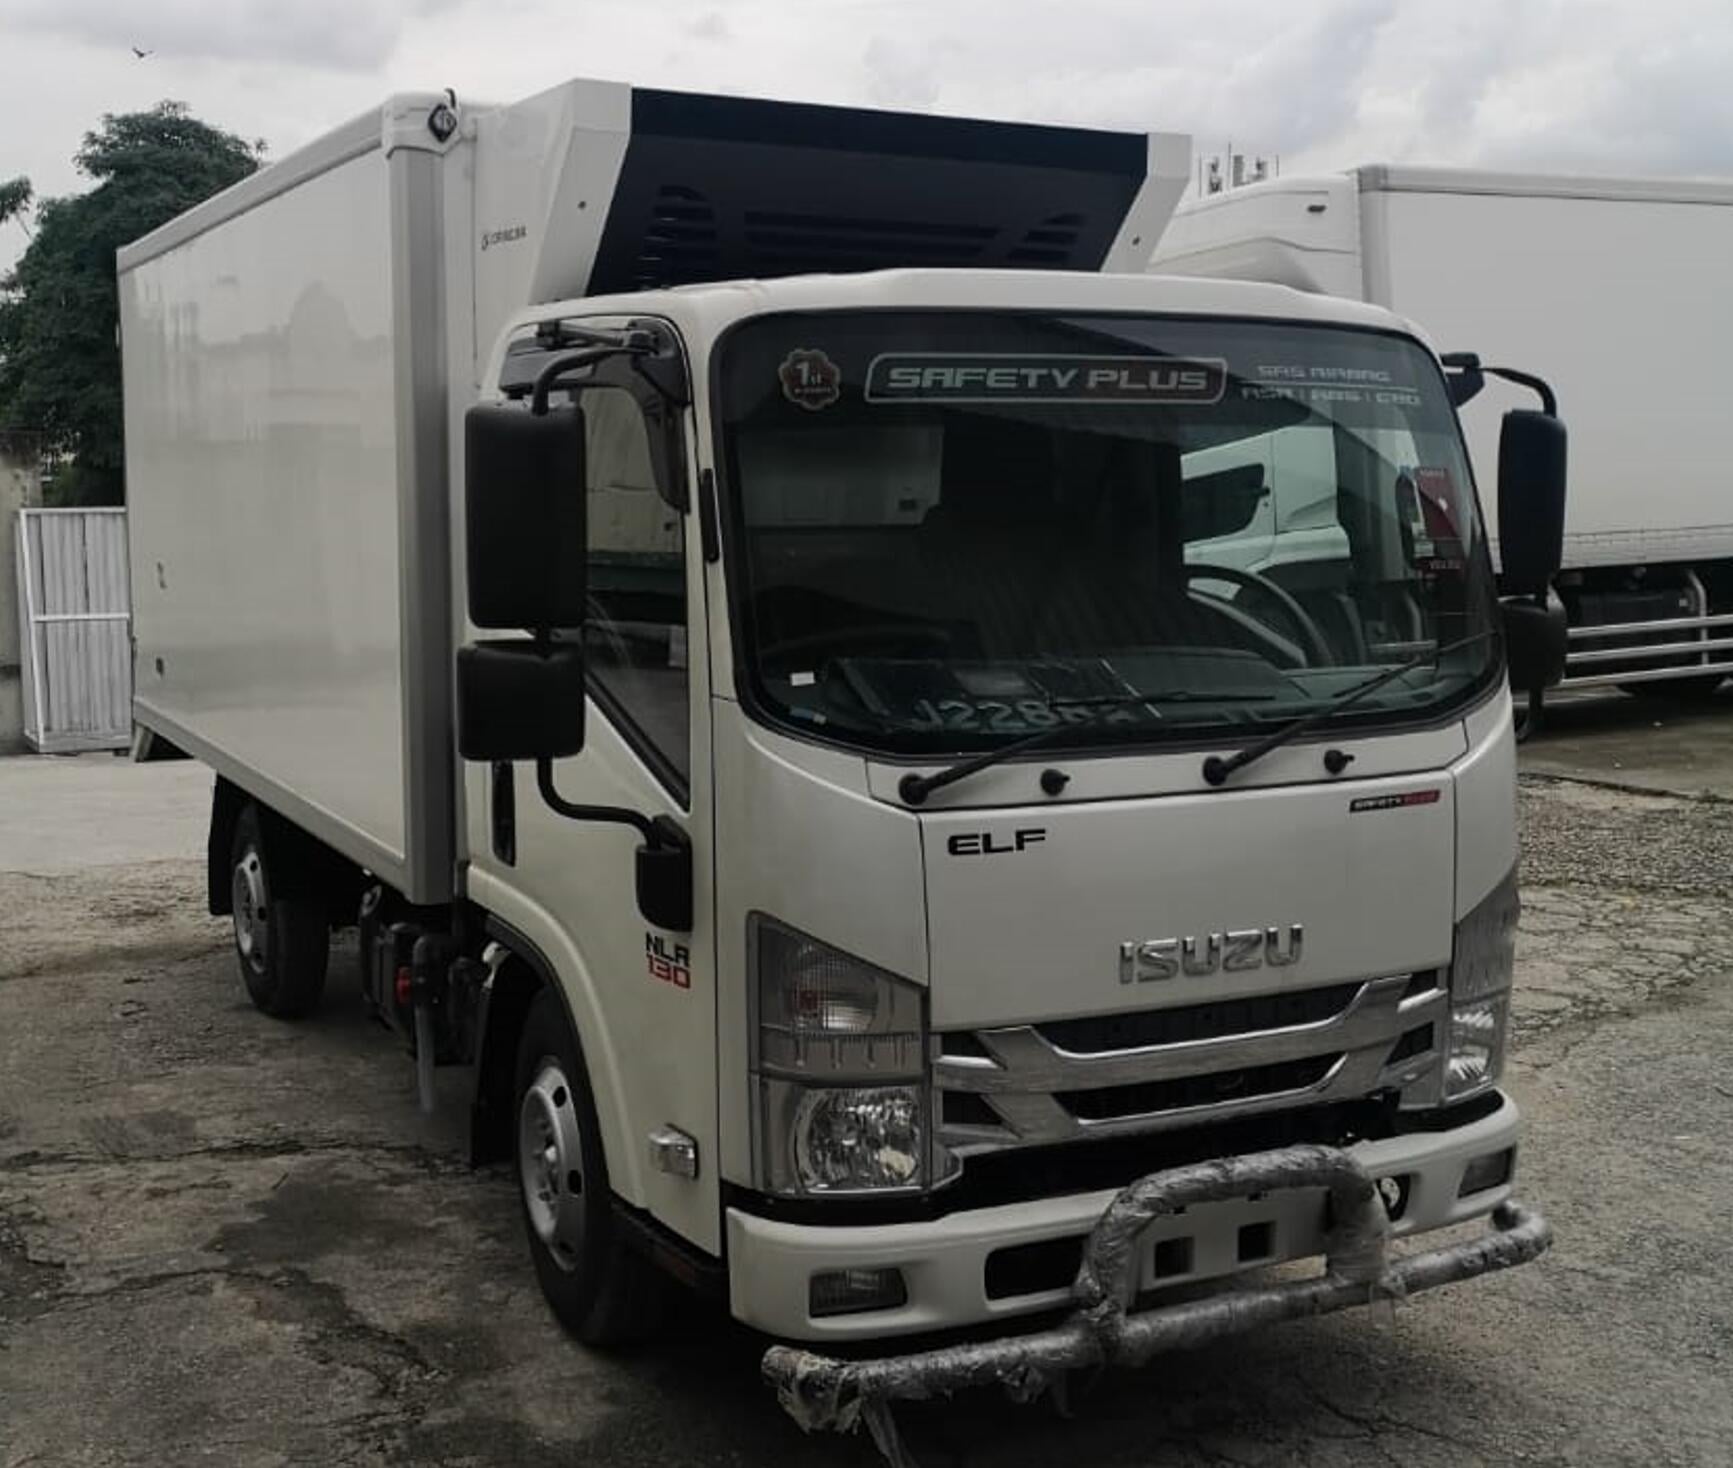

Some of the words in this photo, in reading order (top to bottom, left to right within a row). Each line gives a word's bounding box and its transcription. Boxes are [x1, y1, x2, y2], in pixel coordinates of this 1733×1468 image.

[888, 367, 1080, 389] SAFETY
[1086, 369, 1209, 391] PLUS
[948, 828, 1046, 856] ELF
[645, 931, 690, 968] NLR
[1119, 923, 1304, 985] ISUZU
[646, 953, 691, 989] 130
